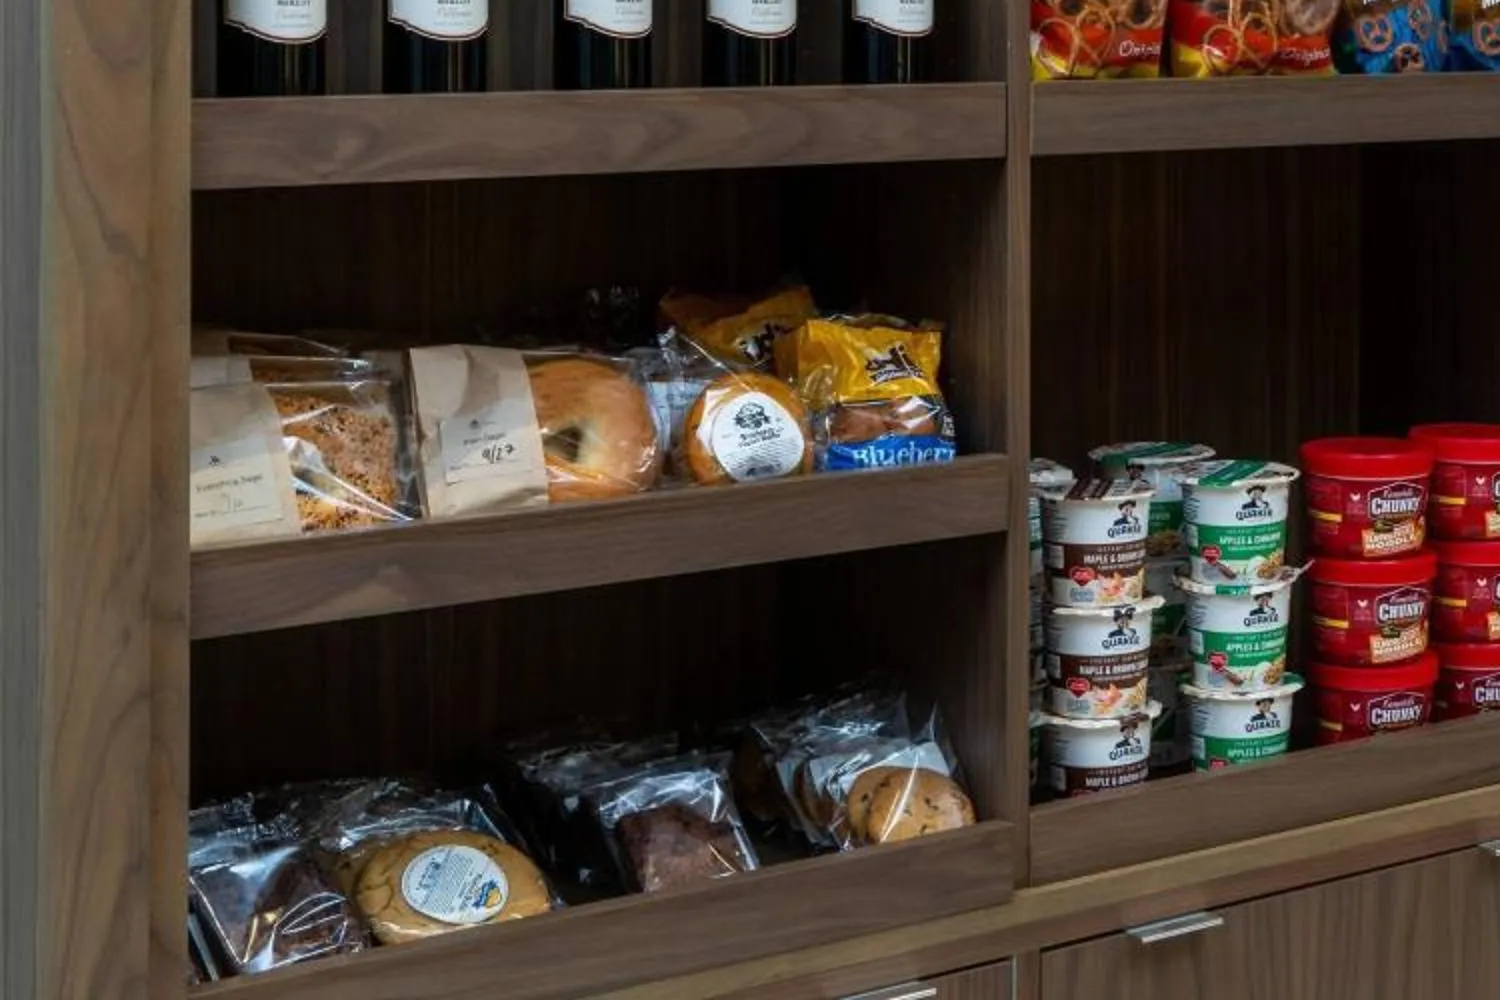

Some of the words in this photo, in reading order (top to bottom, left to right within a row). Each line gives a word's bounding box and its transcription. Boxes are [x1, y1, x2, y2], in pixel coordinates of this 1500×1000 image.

[1371, 497, 1421, 515] CHUNKY
[1378, 602, 1425, 621] CHUNKY
[1371, 704, 1421, 724] CHUNKY
